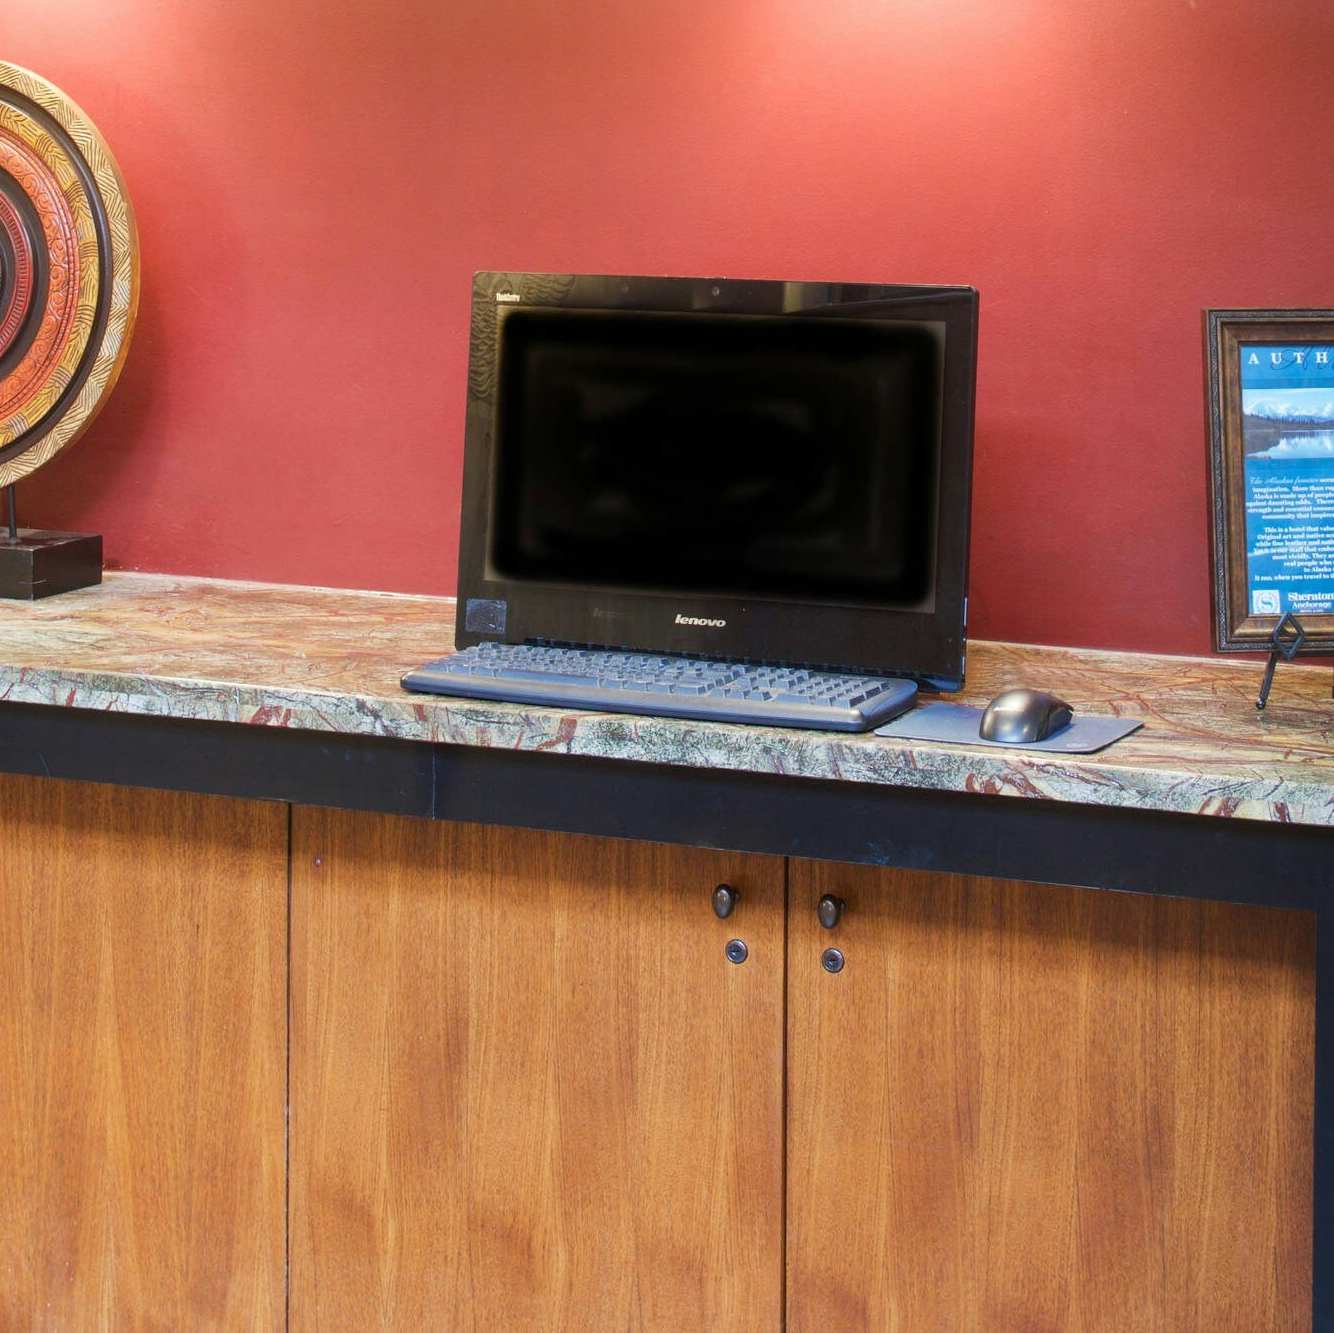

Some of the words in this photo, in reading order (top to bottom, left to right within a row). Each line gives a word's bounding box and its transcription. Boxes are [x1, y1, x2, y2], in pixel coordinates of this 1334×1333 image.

[1287, 592, 1334, 601] Sheraton
[1292, 601, 1332, 609] Anchorage
[674, 613, 727, 628] lenovo
